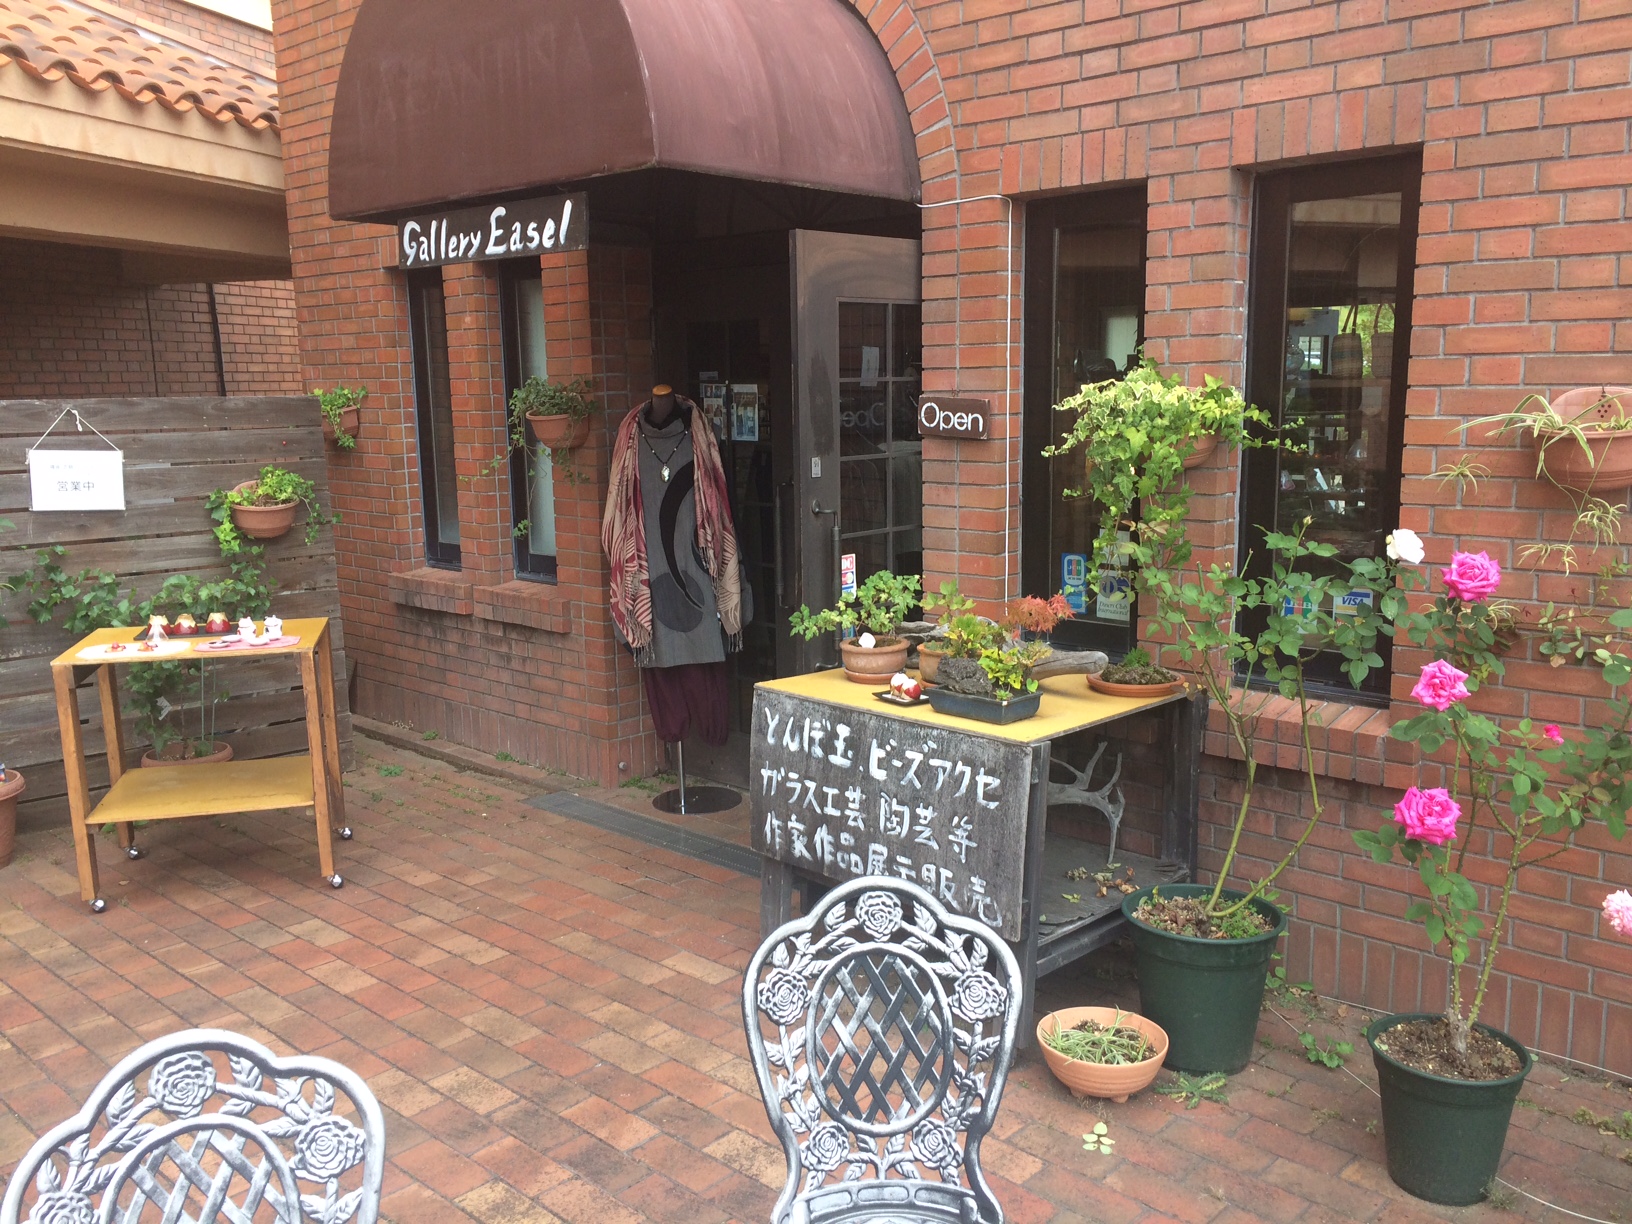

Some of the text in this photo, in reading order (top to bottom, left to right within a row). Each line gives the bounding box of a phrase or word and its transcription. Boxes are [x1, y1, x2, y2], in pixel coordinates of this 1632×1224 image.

[403, 200, 573, 266] Gallery Easel
[921, 402, 983, 432] Open
[57, 481, 94, 491] 営業中
[1342, 596, 1364, 606] VISA
